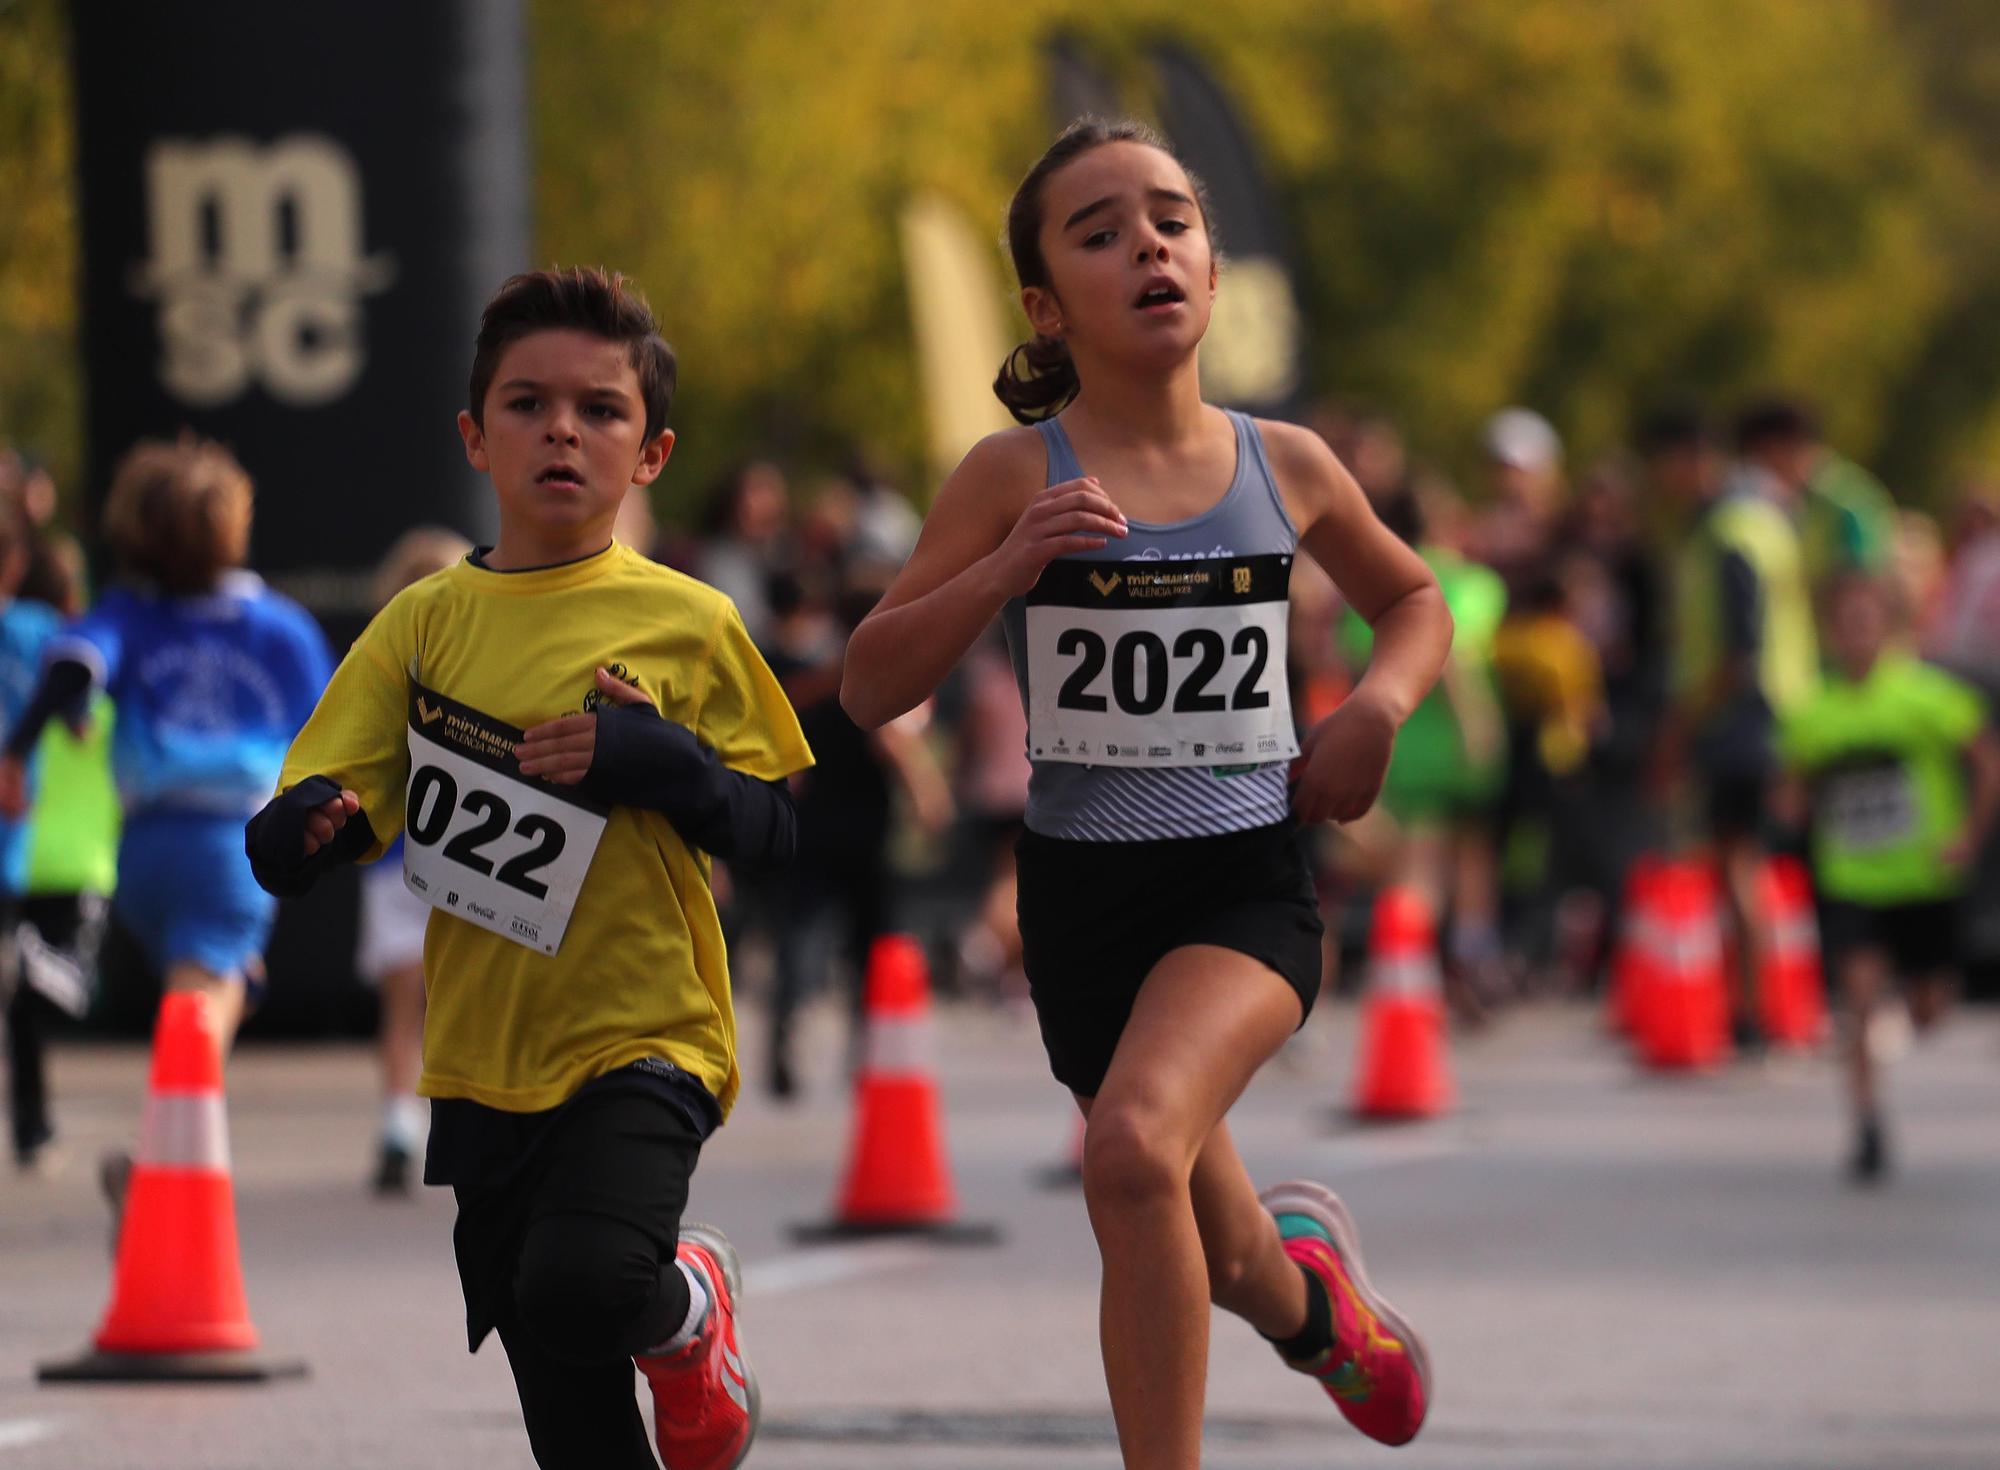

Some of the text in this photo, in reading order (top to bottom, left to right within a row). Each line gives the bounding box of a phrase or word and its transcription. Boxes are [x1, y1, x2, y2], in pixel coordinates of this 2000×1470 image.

[1128, 585, 1171, 598] VALENCIA
[1057, 626, 1269, 715] 2022
[446, 713, 480, 736] mini
